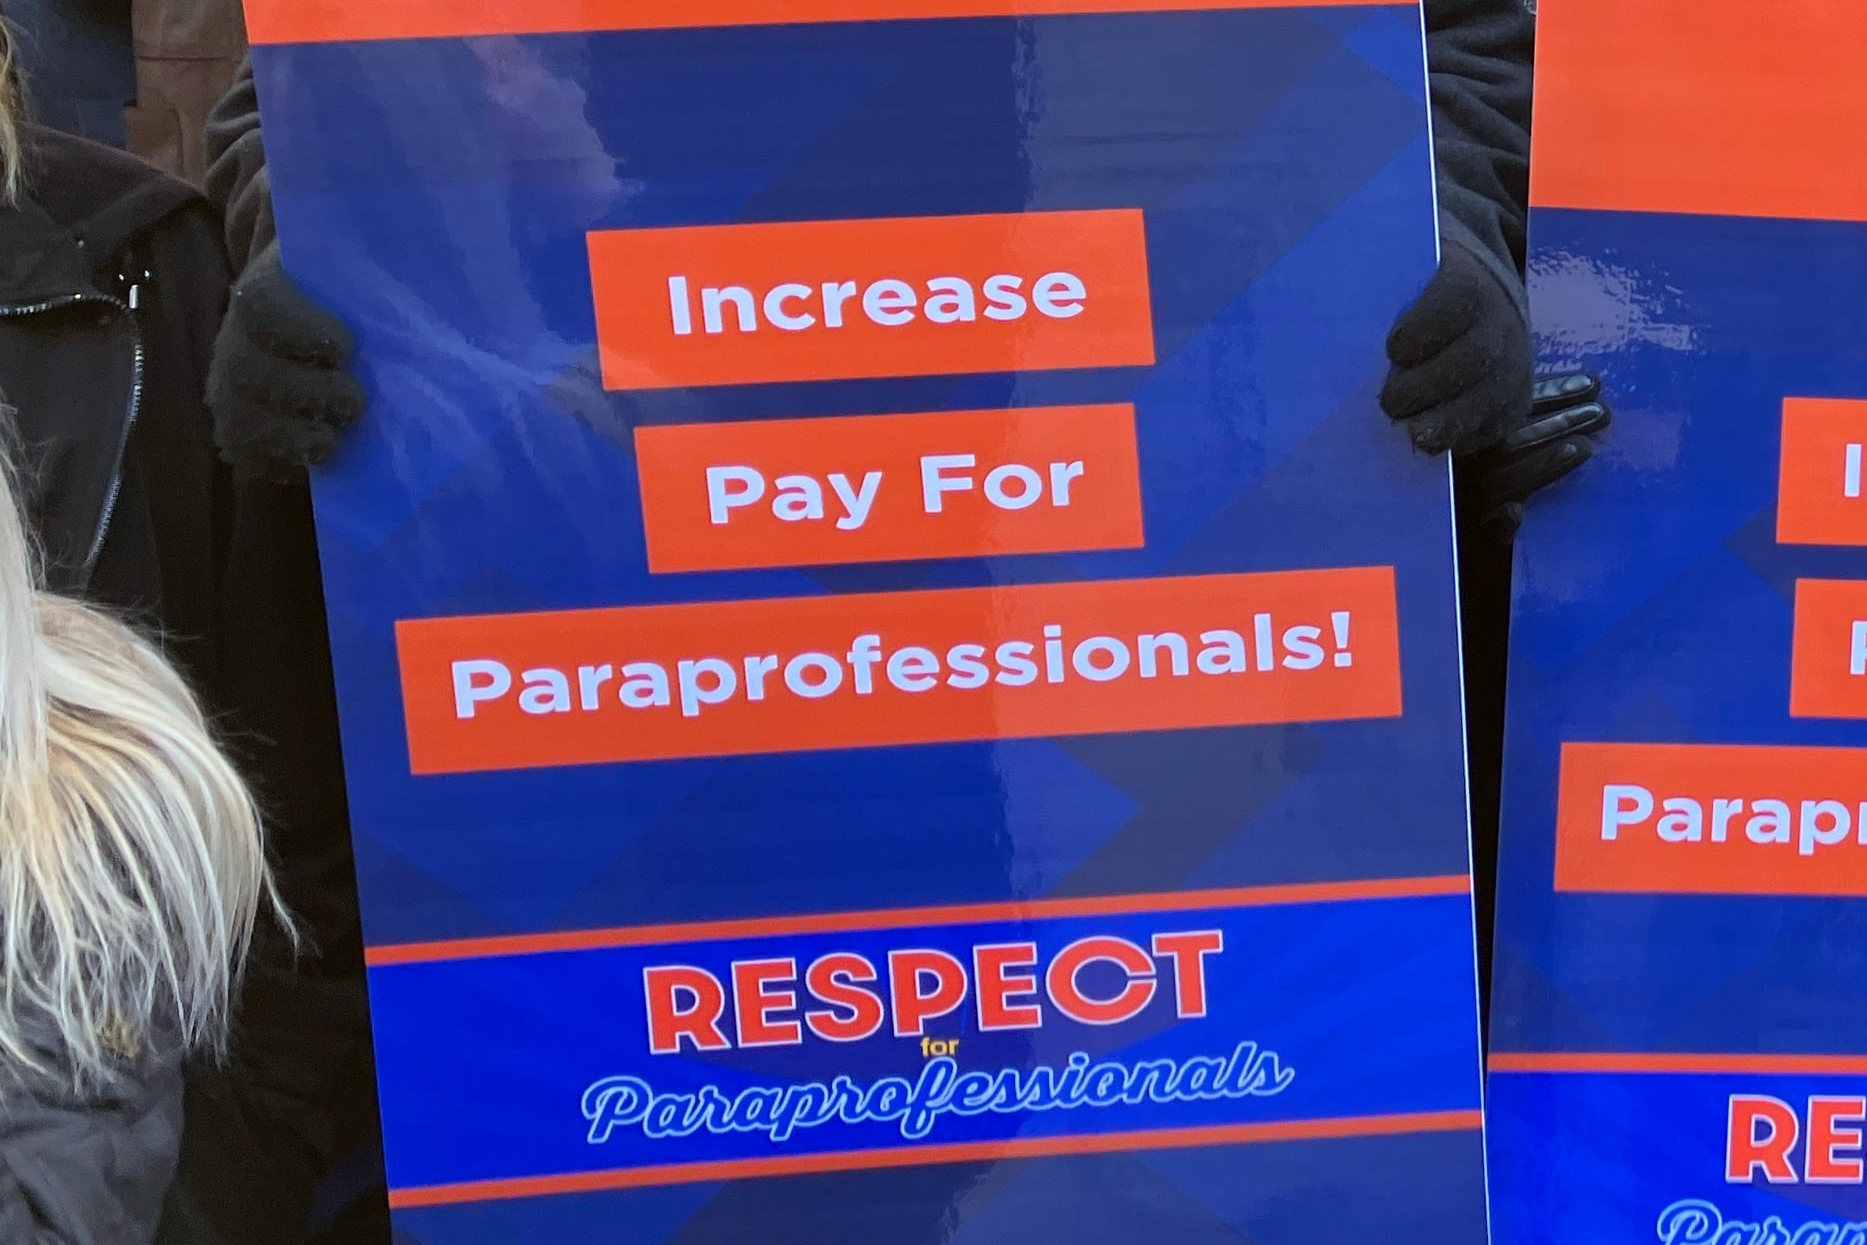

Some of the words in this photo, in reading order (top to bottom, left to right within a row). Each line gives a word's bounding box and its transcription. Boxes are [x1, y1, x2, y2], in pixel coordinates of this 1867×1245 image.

[667, 270, 1087, 336] Increase
[705, 465, 883, 532] Pay
[919, 453, 1084, 514] For
[450, 610, 1353, 719] Paraprofessionals!
[642, 929, 1224, 1056] RESPECT
[581, 1040, 1296, 1144] Paraprofessionals
[919, 1035, 960, 1058] for
